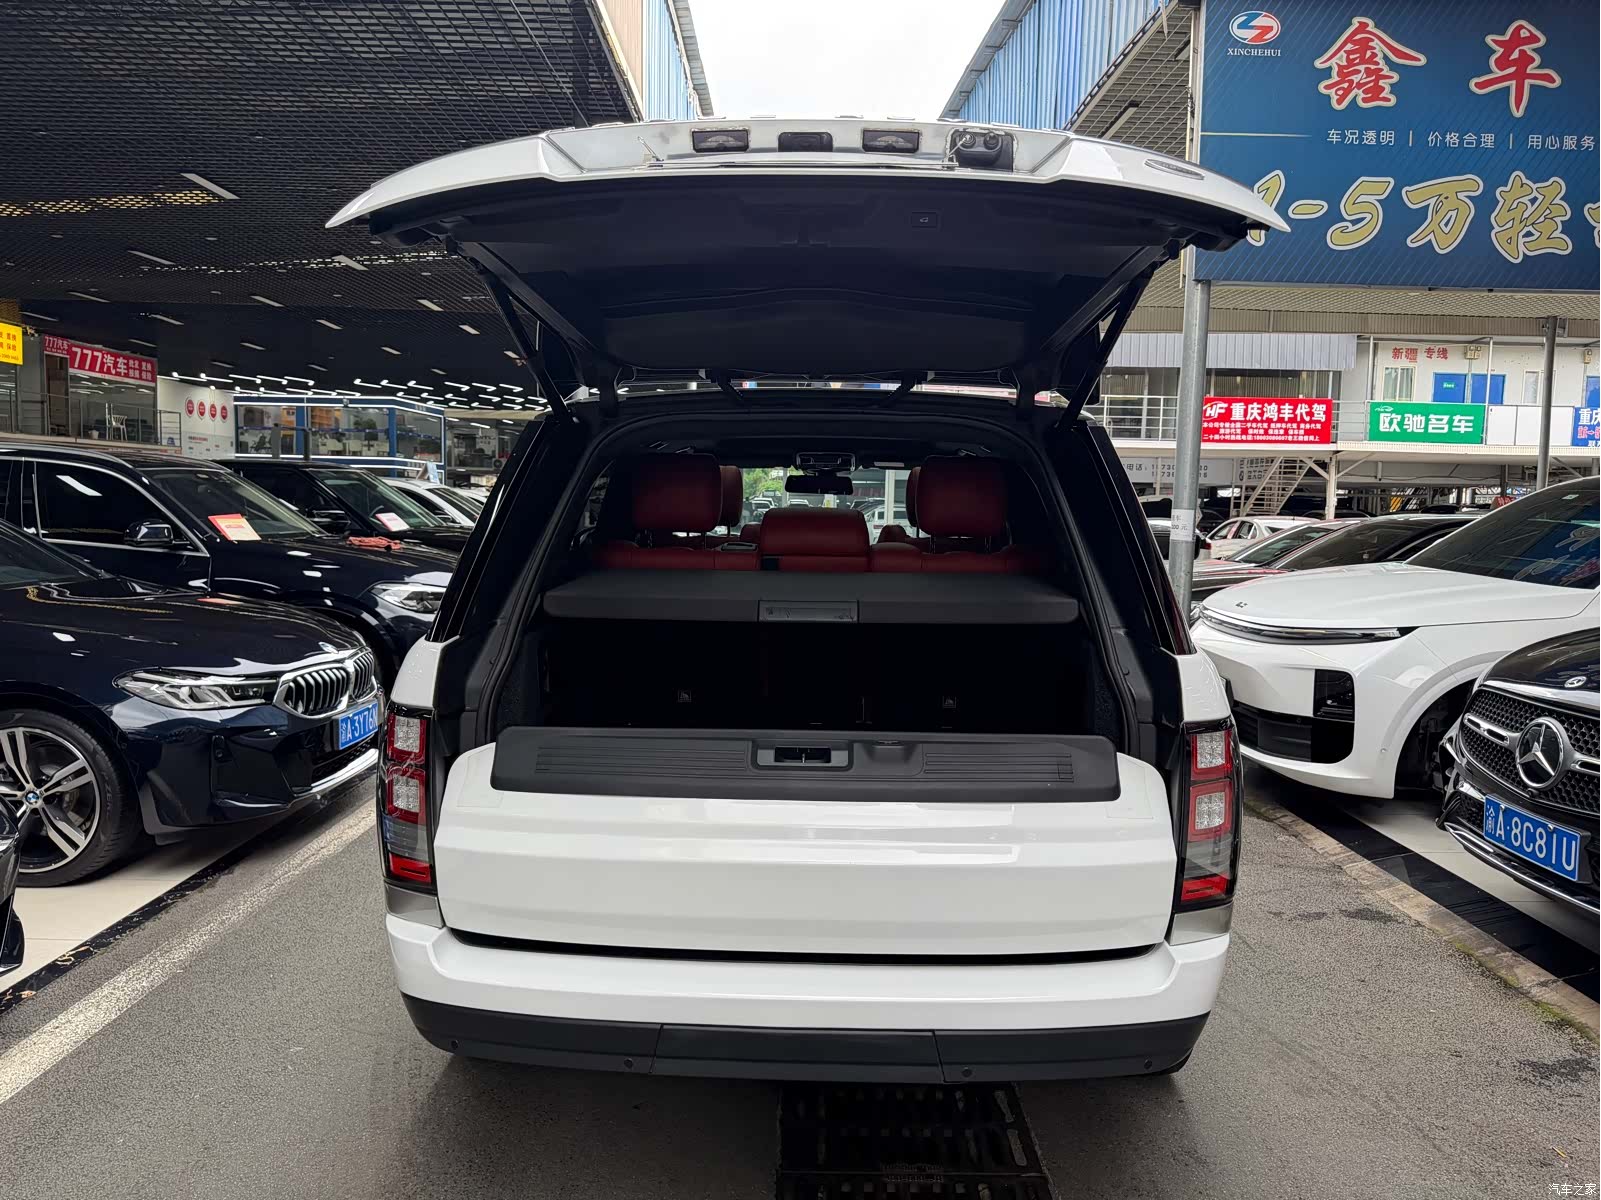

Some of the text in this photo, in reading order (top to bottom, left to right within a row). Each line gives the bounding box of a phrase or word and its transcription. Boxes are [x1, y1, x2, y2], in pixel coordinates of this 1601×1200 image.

[1227, 48, 1281, 57] XINCHEHUI
[1327, 128, 1595, 151] 车况透明 价格合理 用心服务
[1246, 170, 1600, 263] 1-5万轻
[71, 347, 128, 376] 777汽车
[1392, 346, 1448, 362] 新疆 专线
[1230, 402, 1327, 421] 重庆鸿丰代驾
[1379, 412, 1474, 433] 欧驰名车
